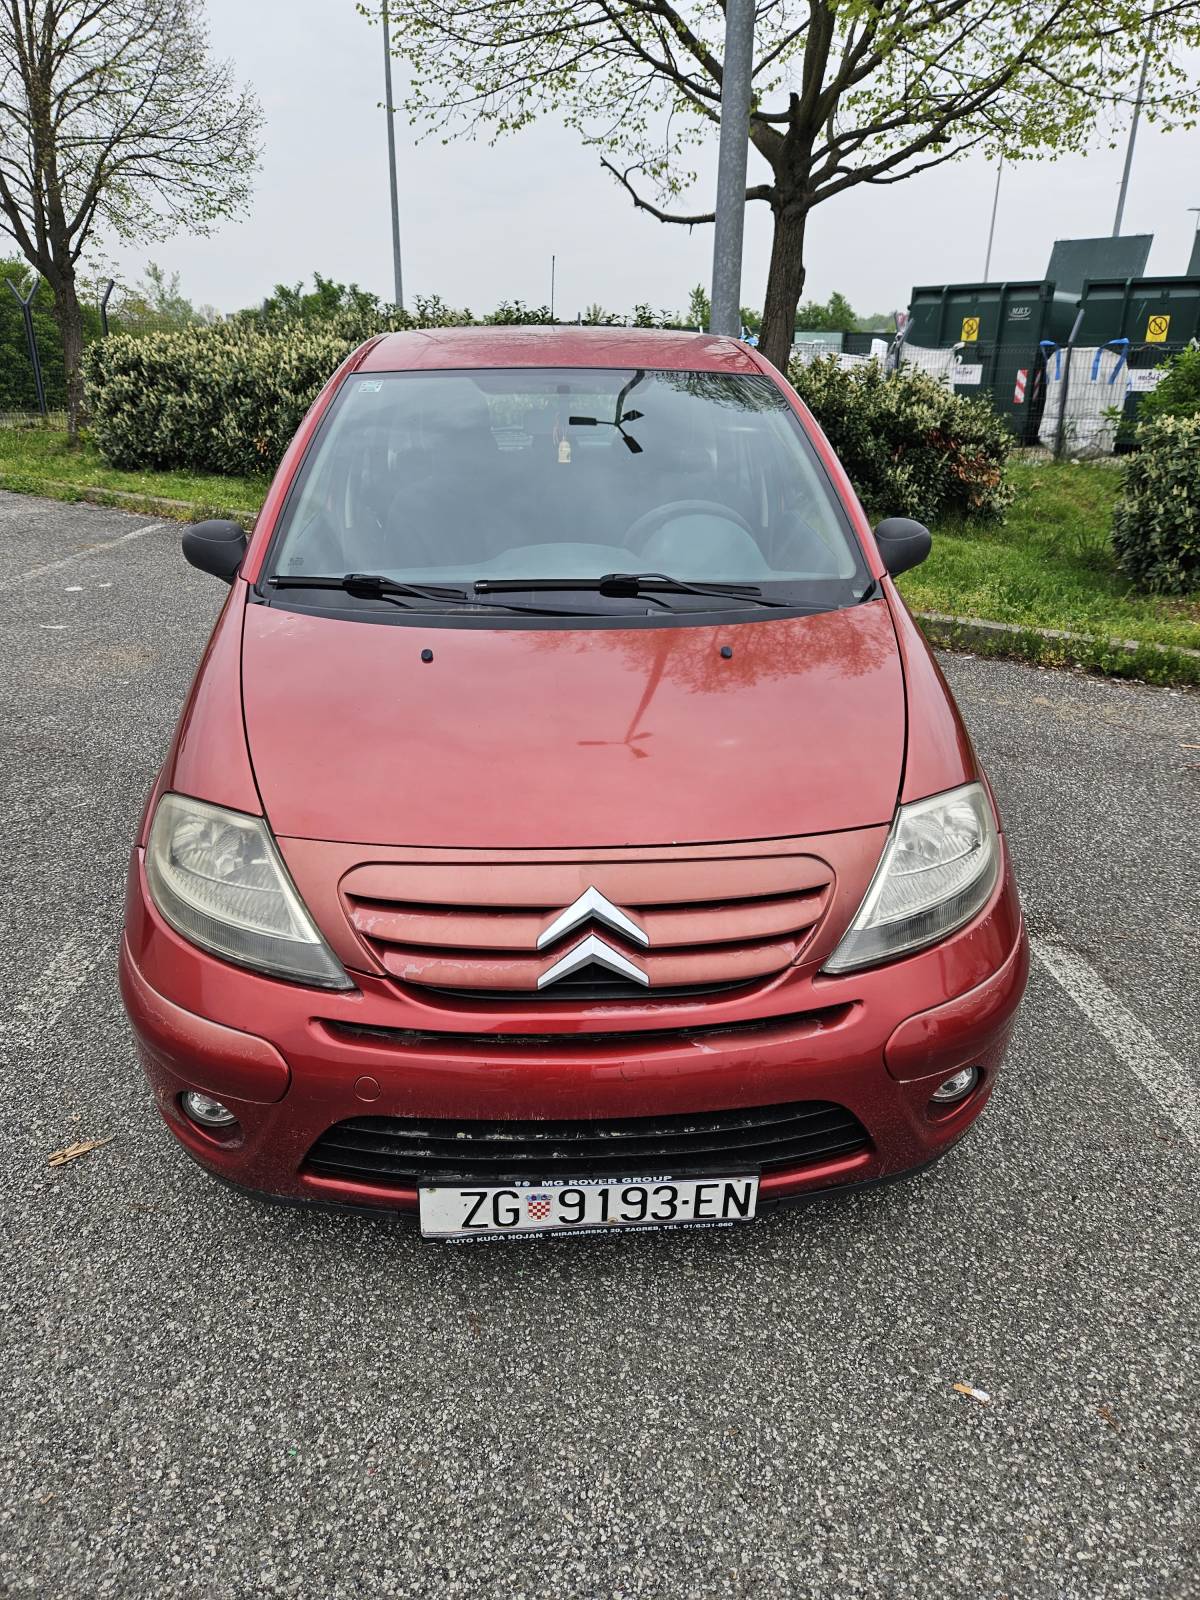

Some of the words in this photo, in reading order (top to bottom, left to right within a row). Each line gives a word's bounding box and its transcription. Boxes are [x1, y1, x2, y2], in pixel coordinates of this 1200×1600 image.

[568, 1178, 618, 1186] ROVER
[621, 1175, 673, 1184] GROUP
[460, 1190, 520, 1229] ZG
[558, 1183, 752, 1224] 9193-EN
[507, 1232, 544, 1240] HOJAN
